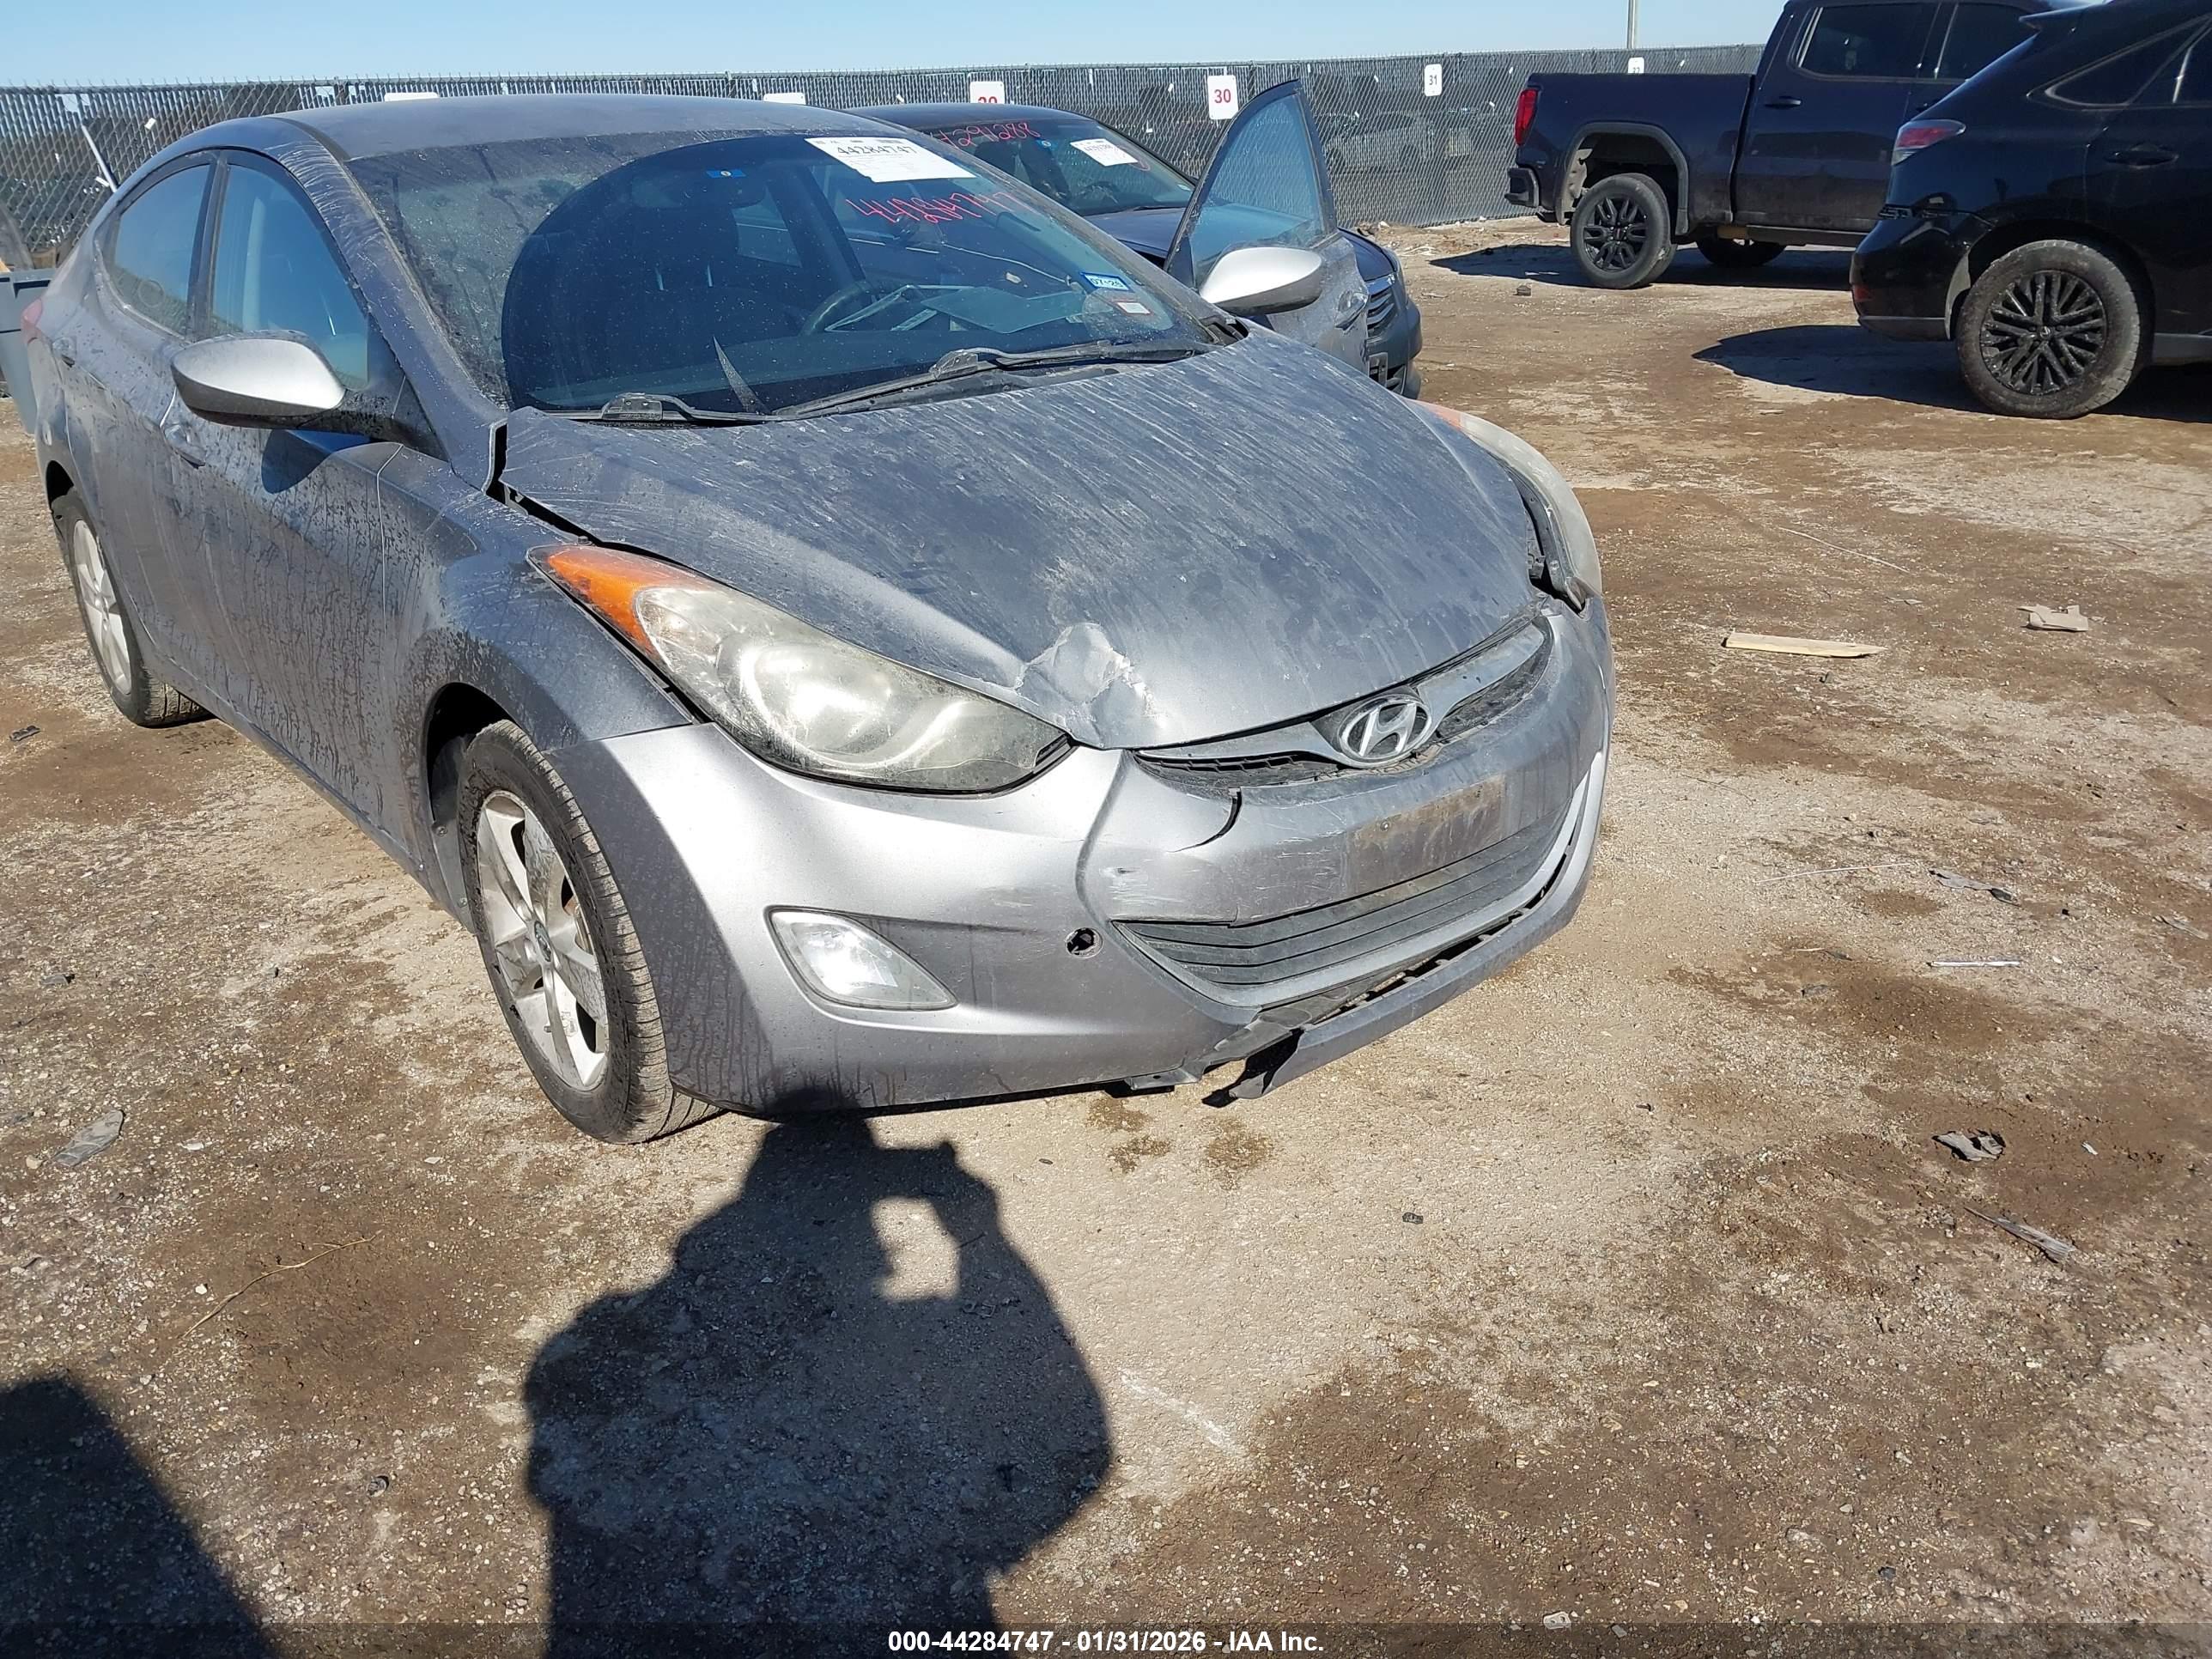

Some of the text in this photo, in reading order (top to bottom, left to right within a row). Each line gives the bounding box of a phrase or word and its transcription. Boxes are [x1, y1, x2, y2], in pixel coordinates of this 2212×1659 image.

[1429, 75, 1437, 86] 31
[1214, 88, 1231, 104] 30
[837, 145, 918, 155] 44284747
